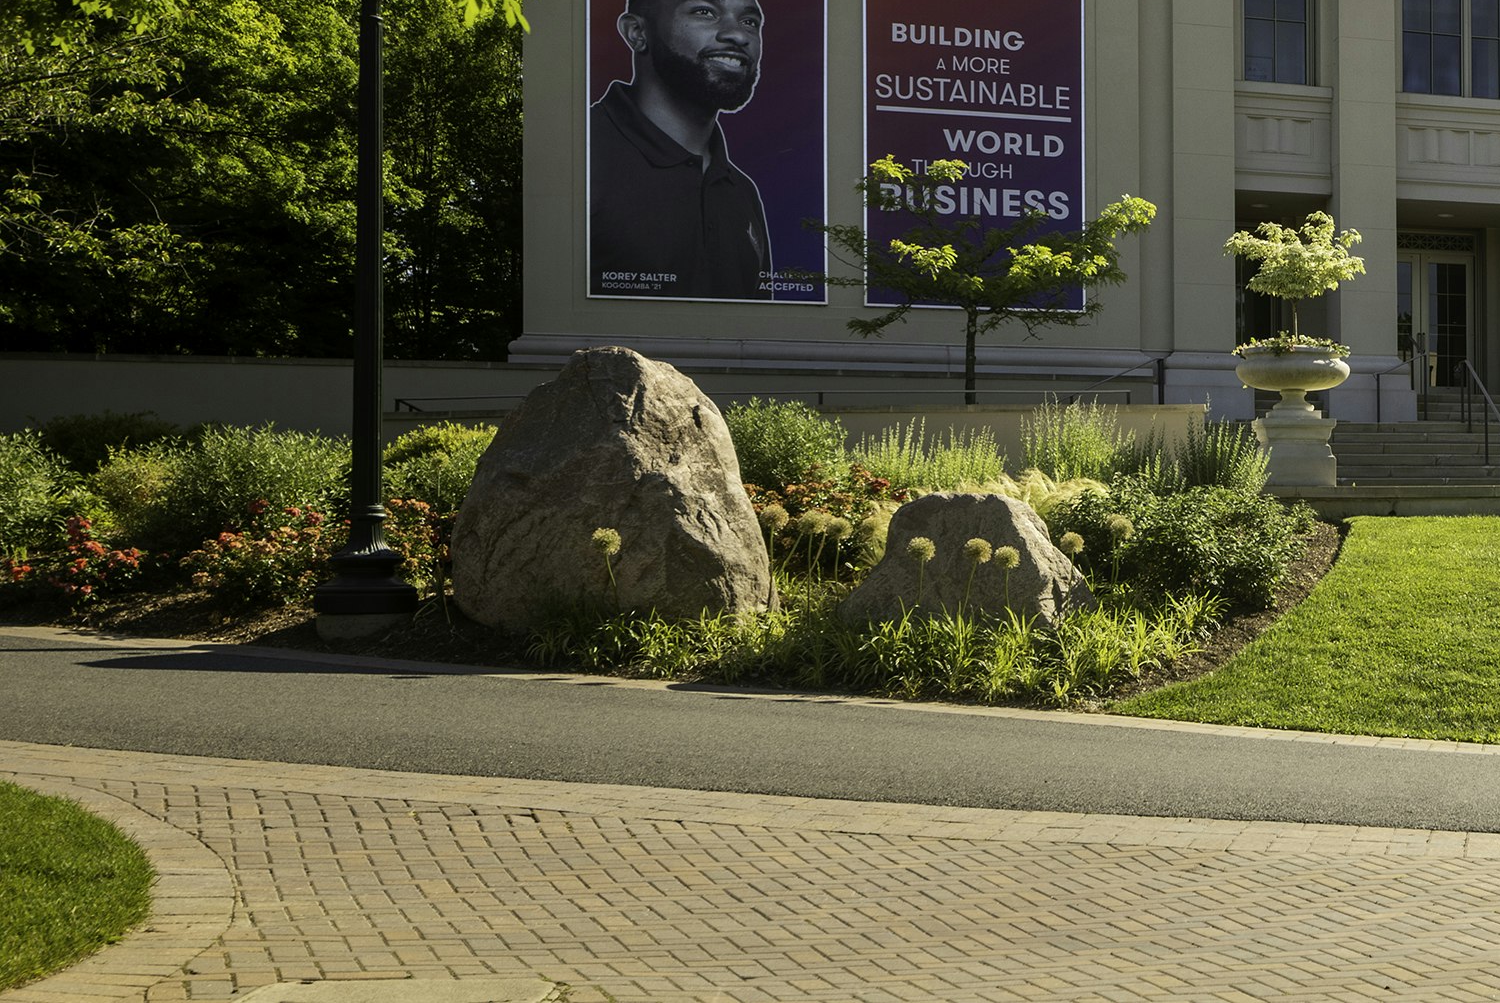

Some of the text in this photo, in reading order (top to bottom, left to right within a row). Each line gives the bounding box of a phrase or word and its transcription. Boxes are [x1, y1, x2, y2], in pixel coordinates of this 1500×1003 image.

[891, 22, 1025, 52] BUILDING
[936, 55, 1010, 75] A MORE
[875, 73, 1070, 110] SUSTAINABLE
[943, 128, 1064, 157] WORLD
[911, 158, 1013, 180] THUGH
[879, 183, 1070, 220] BUSINESS
[601, 282, 650, 290] KOGOD/MBA
[602, 271, 677, 282] KOREY SALTER
[758, 282, 814, 292] ACCEPTED
